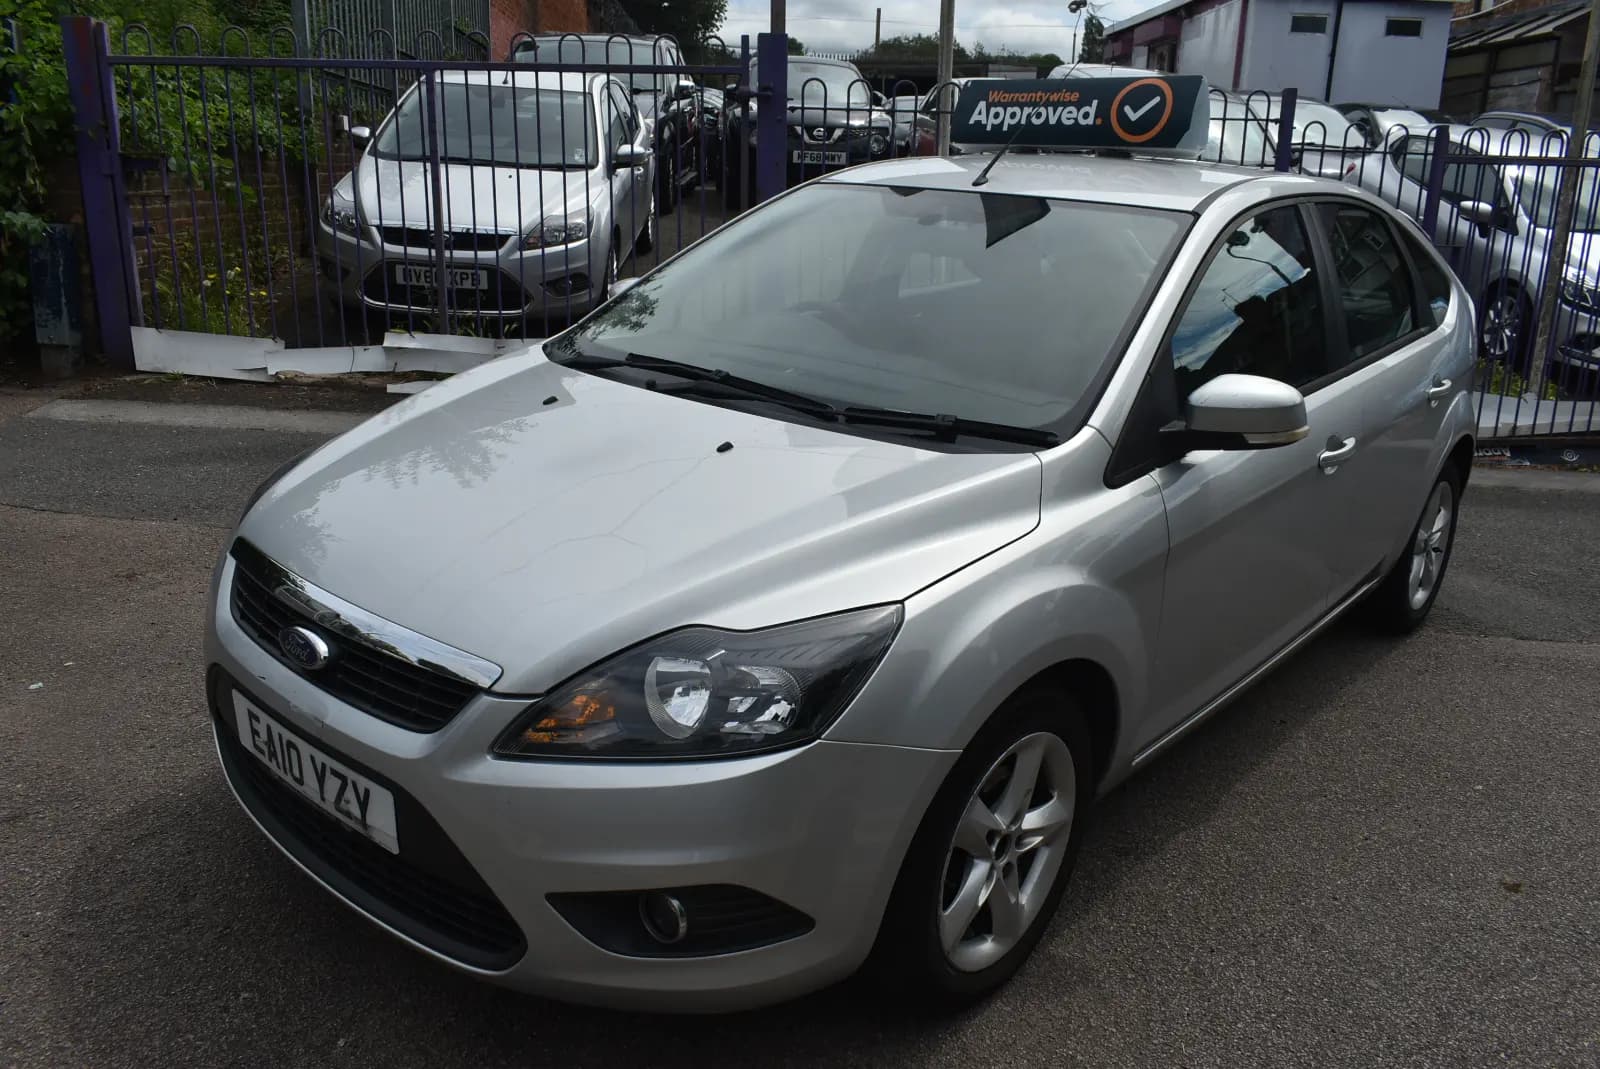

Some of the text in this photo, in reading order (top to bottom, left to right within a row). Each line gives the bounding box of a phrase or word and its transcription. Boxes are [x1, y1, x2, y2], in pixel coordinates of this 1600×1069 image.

[987, 88, 1080, 105] Warrantywise
[247, 708, 371, 832] EA10 YZY
